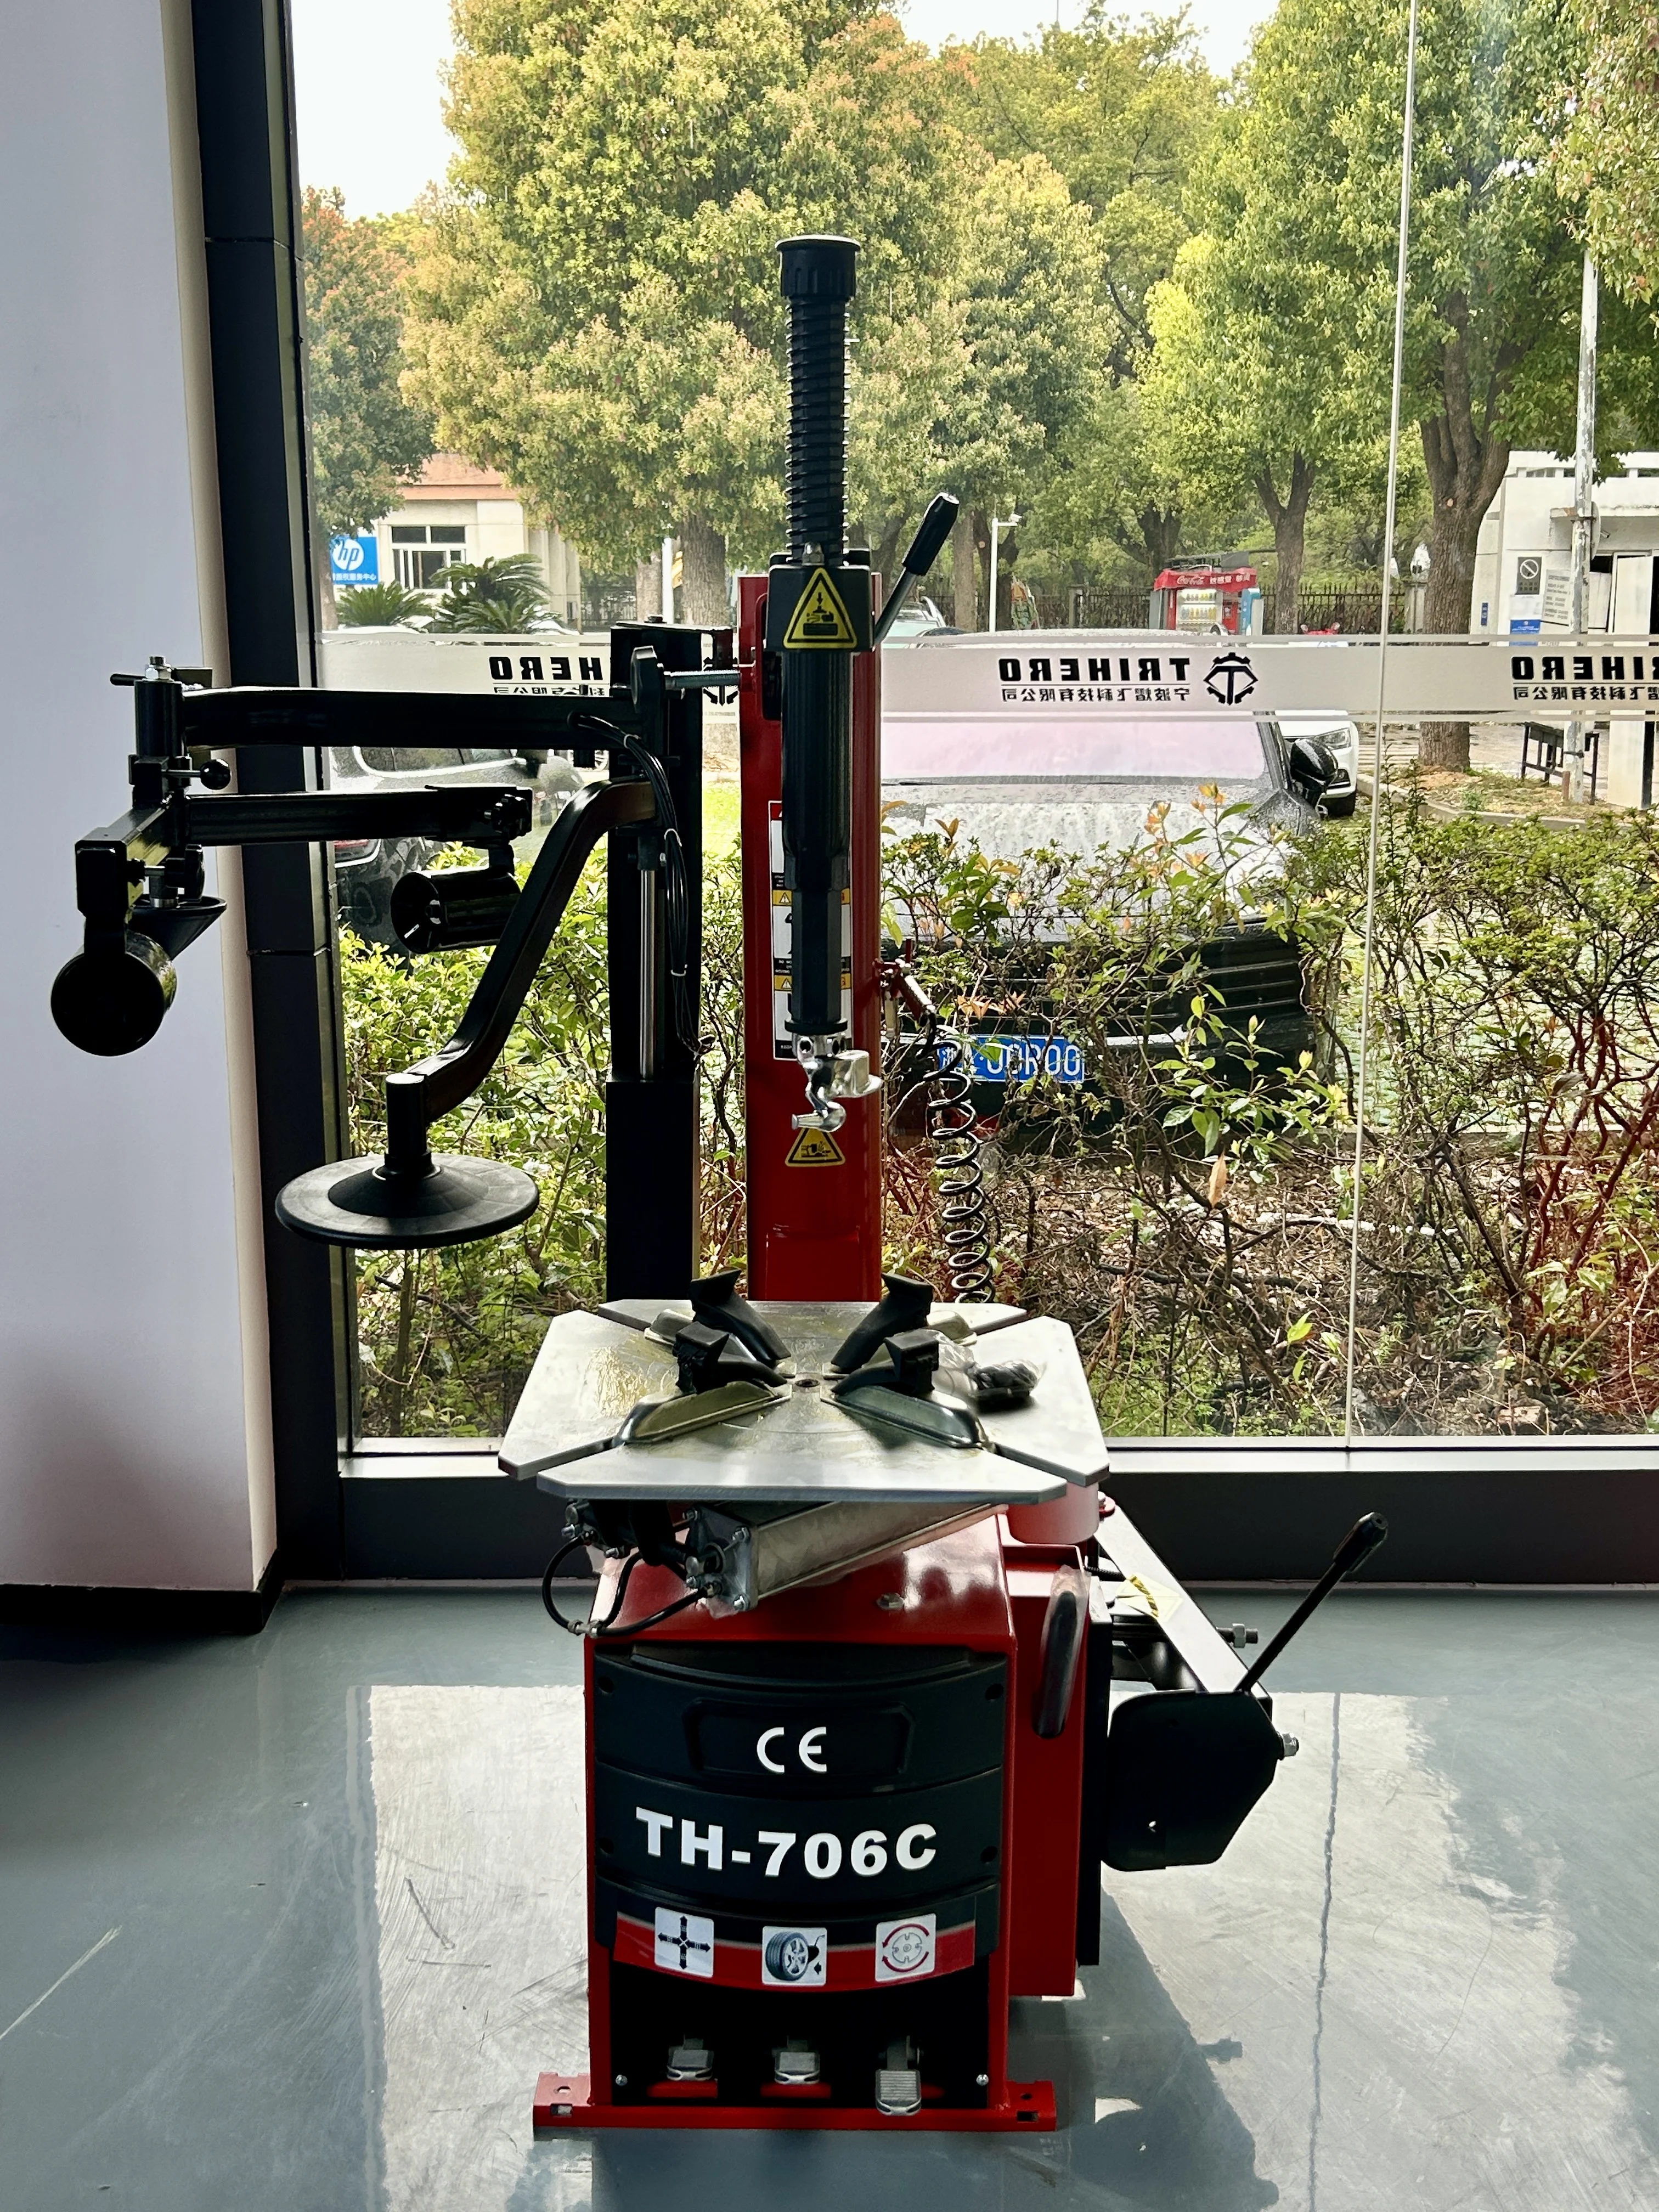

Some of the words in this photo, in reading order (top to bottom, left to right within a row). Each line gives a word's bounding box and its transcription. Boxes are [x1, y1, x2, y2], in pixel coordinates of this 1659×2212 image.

[337, 539, 360, 571] hp
[757, 1726, 827, 1773] CE
[636, 1807, 937, 1879] TH-706C
